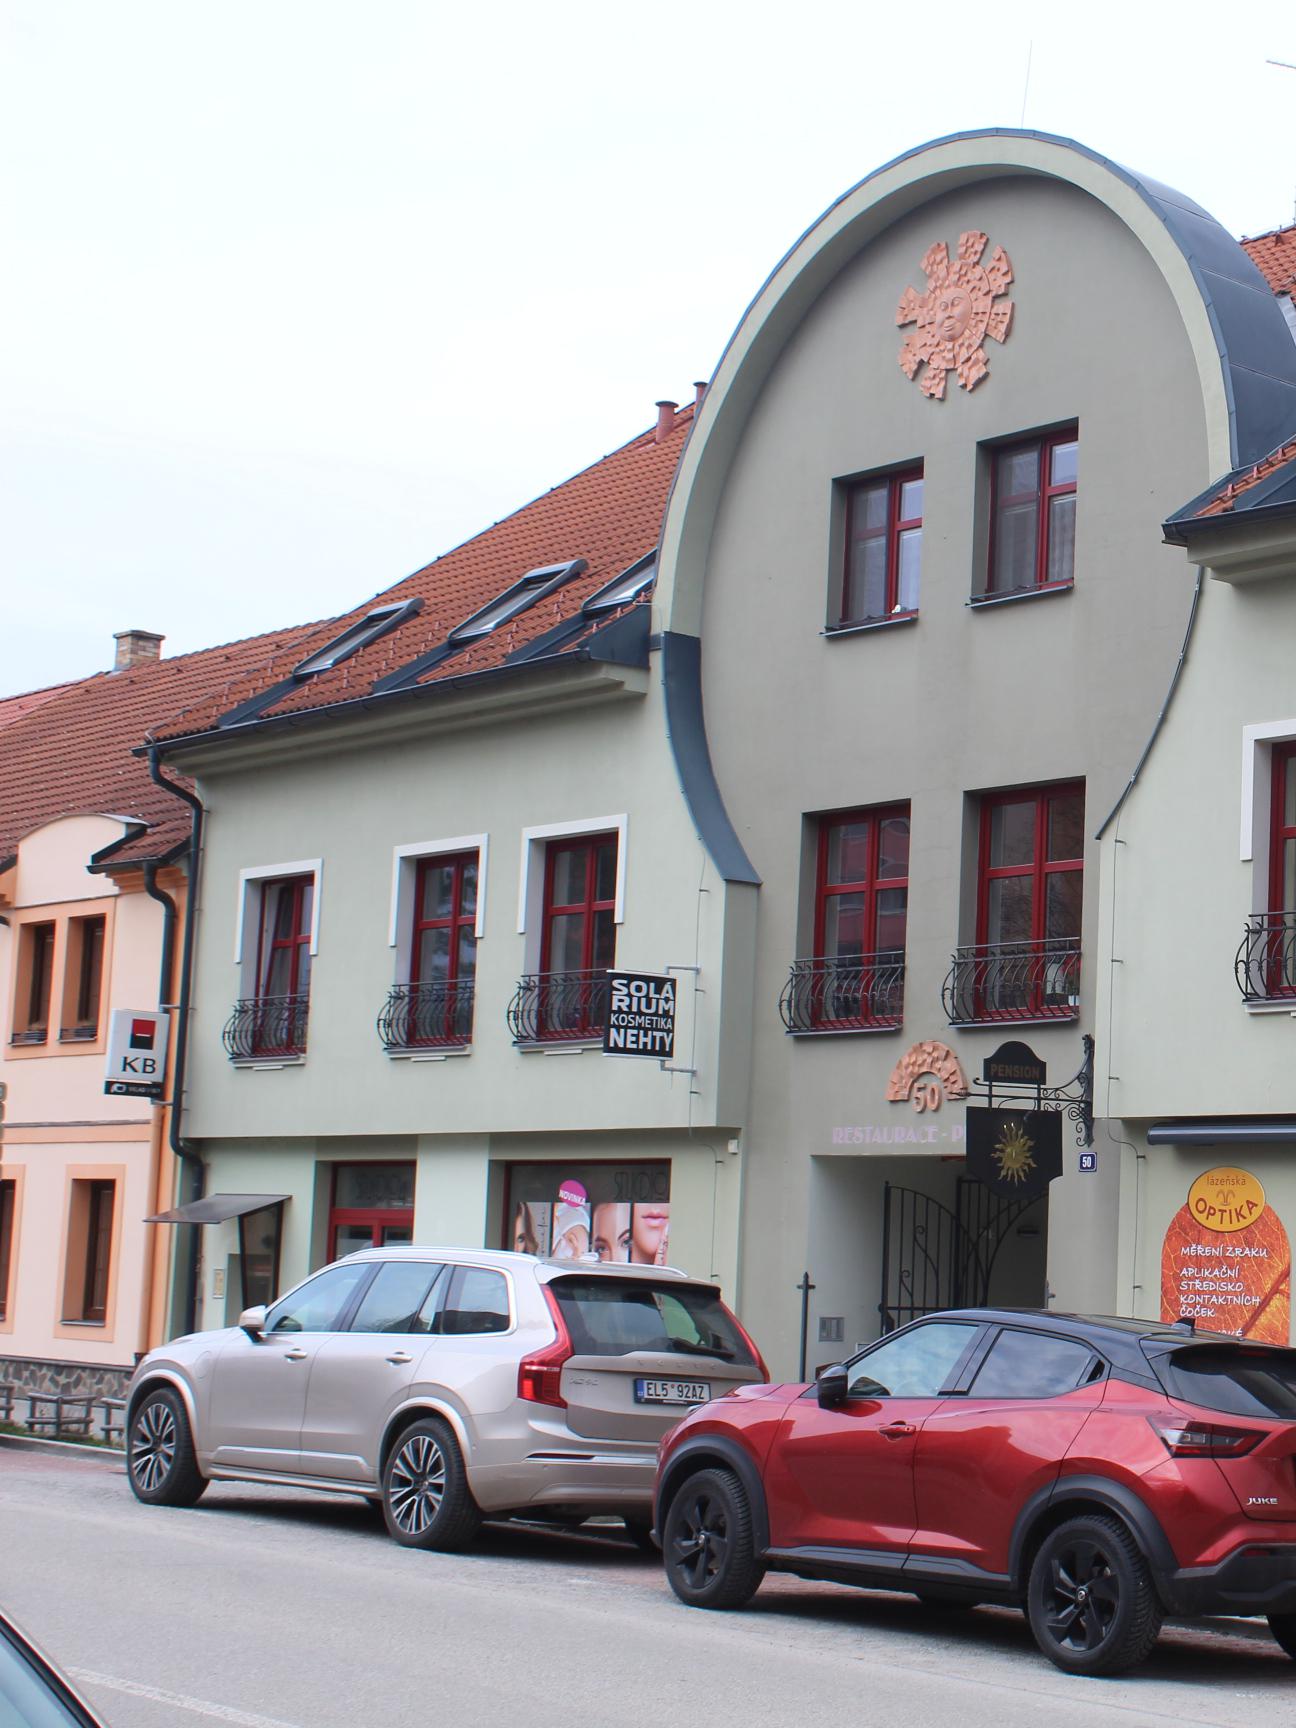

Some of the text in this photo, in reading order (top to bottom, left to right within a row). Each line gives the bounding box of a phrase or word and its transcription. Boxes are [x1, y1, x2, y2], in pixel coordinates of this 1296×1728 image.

[611, 979, 675, 1000] SOLÁ
[611, 995, 675, 1015] RIUM
[610, 1013, 673, 1030] KOSMETIKA
[609, 1027, 673, 1052] NEHTY
[121, 1055, 156, 1074] KB
[990, 1063, 1040, 1080] PENSION
[911, 1082, 940, 1113] 50
[832, 1125, 938, 1145] RESTAURACE
[1081, 1155, 1092, 1168] 50
[1206, 1176, 1247, 1187] lázeňská
[1195, 1197, 1259, 1225] OPTIKA
[1180, 1243, 1269, 1258] MĚŘENÍ ZRAKU
[1180, 1265, 1240, 1278] APLIKAČNÍ
[1180, 1279, 1244, 1292] STŘEDISKO
[1180, 1293, 1261, 1307] KONTAKTNÍCH
[1180, 1304, 1216, 1317] ČOČEK
[646, 1382, 705, 1400] EL5 92AZ
[1246, 1497, 1278, 1506] JUKE
